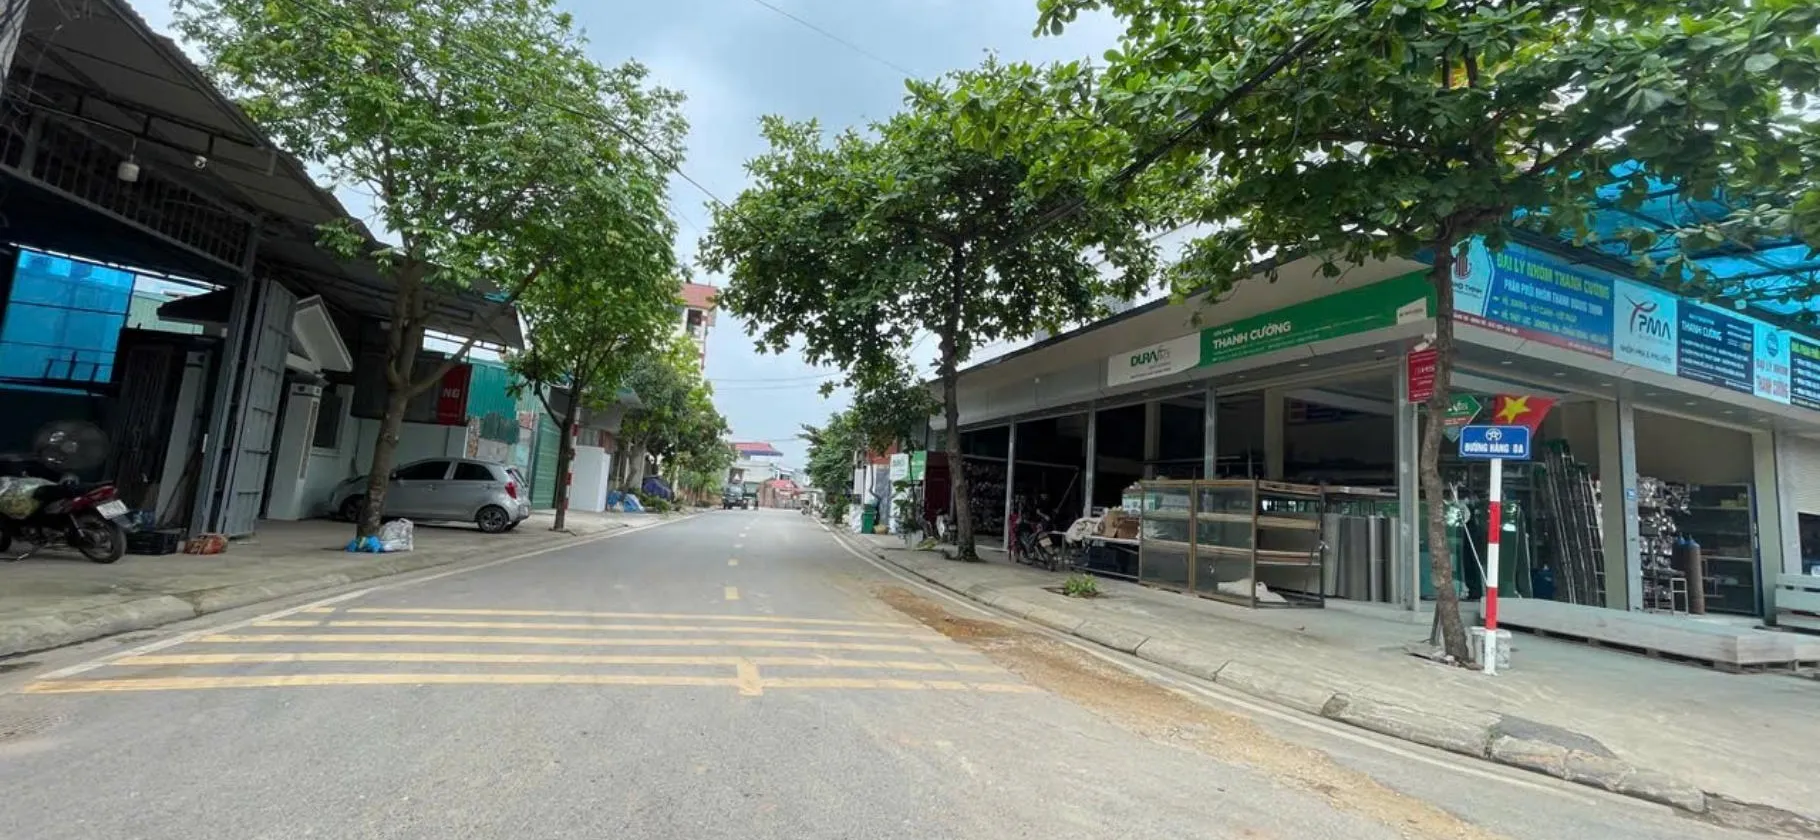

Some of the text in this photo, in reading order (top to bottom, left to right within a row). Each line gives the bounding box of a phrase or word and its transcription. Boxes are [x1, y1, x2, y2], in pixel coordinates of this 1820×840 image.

[1212, 332, 1248, 349] THANH
[1249, 321, 1292, 340] CƯỜNG
[1638, 314, 1672, 340] PMA
